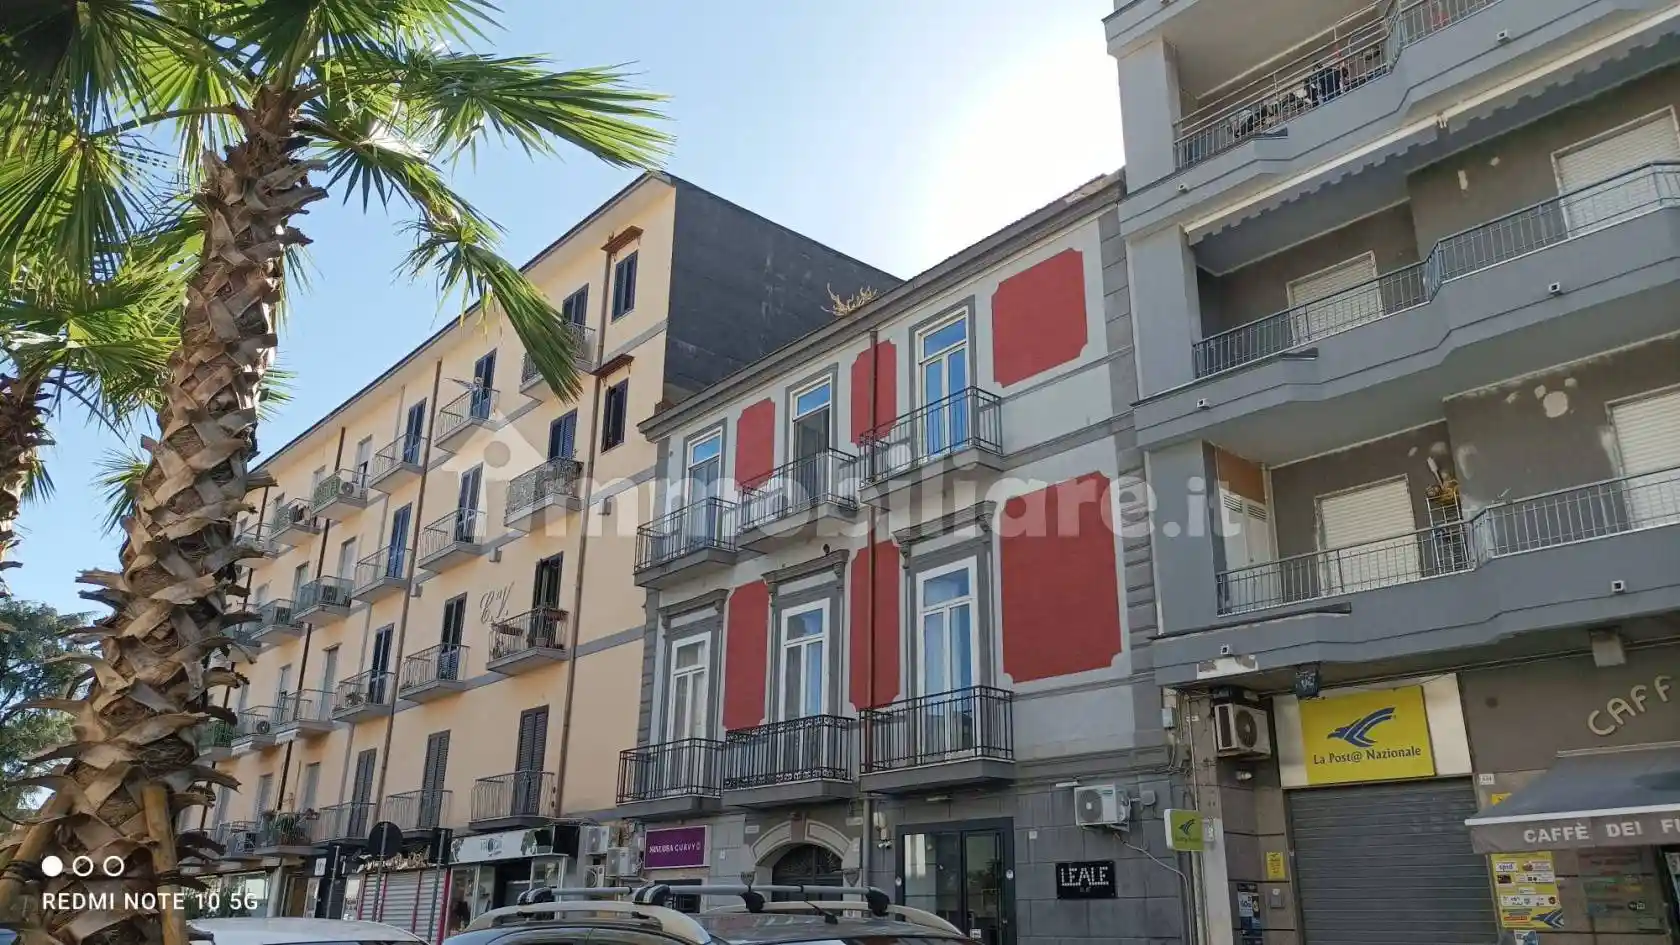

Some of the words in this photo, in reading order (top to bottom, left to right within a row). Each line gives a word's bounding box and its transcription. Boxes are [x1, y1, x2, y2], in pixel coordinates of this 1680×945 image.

[1313, 754, 1325, 765] La
[1329, 751, 1362, 763] Post@
[1366, 745, 1422, 760] Nazionale
[1523, 822, 1590, 843] CAFFÈ
[1605, 820, 1643, 838] DEI
[1061, 866, 1109, 887] LEALE
